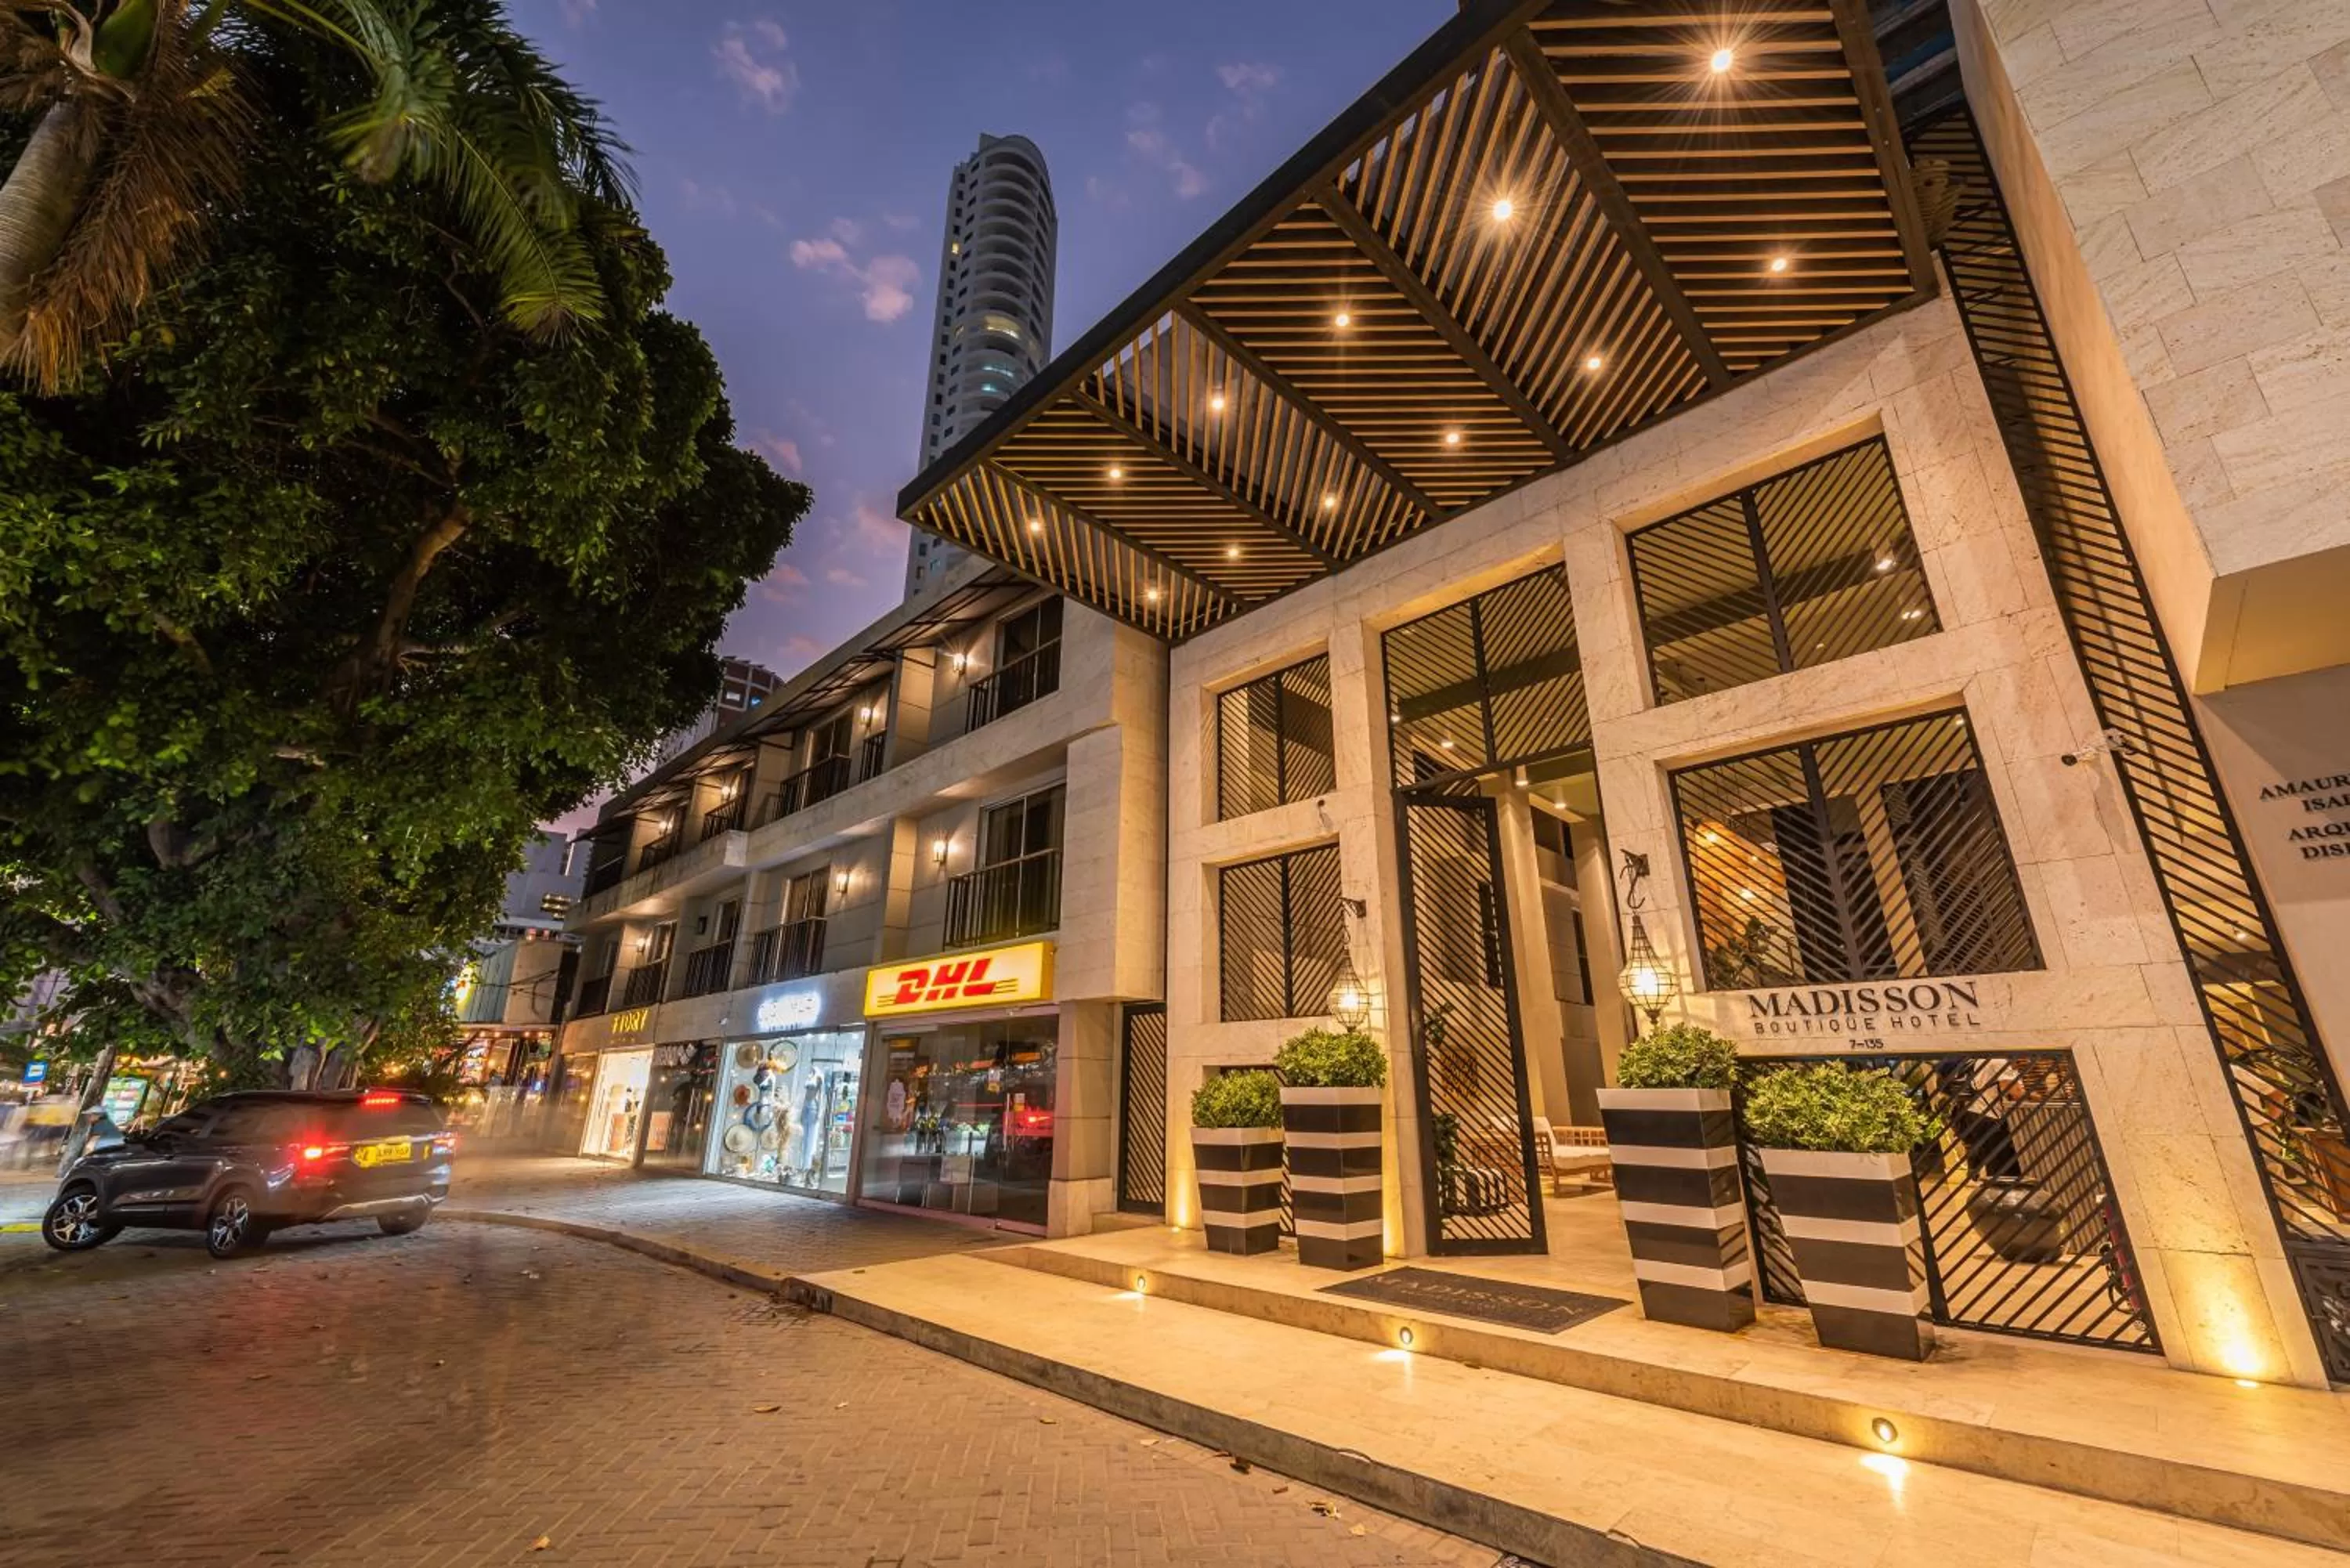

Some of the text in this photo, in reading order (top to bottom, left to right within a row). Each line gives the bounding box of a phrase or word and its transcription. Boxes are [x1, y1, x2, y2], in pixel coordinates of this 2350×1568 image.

[2259, 774, 2350, 800] AMAUR
[895, 958, 996, 1004] DHL
[1747, 981, 1979, 1018] MADISSON
[1754, 1013, 1980, 1034] BOUTIQUE HOTEL
